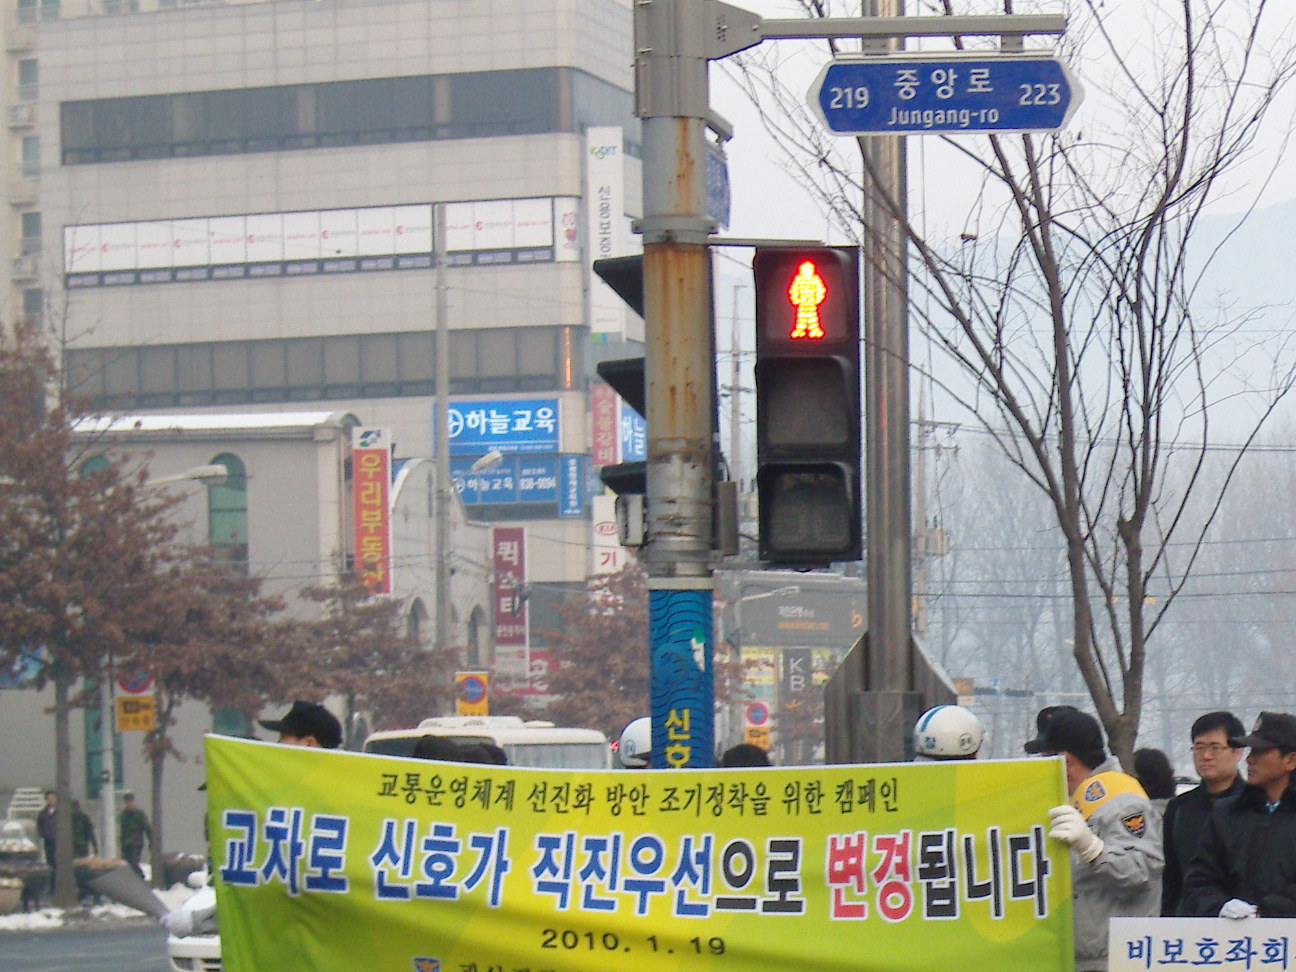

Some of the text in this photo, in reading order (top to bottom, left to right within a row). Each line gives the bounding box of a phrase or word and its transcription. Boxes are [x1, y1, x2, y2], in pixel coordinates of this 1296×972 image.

[893, 68, 993, 100] 중앙로
[1018, 83, 1062, 106] 223
[829, 87, 870, 110] 219
[887, 106, 1000, 128] Jungang-ro
[465, 407, 557, 435] 하늘교육
[377, 772, 899, 817] 교통운영체계 선진화 방안 조기정착을 위한 캠페인
[220, 807, 1050, 922] 교차로 신호가 직진우선으로 변경됩니다
